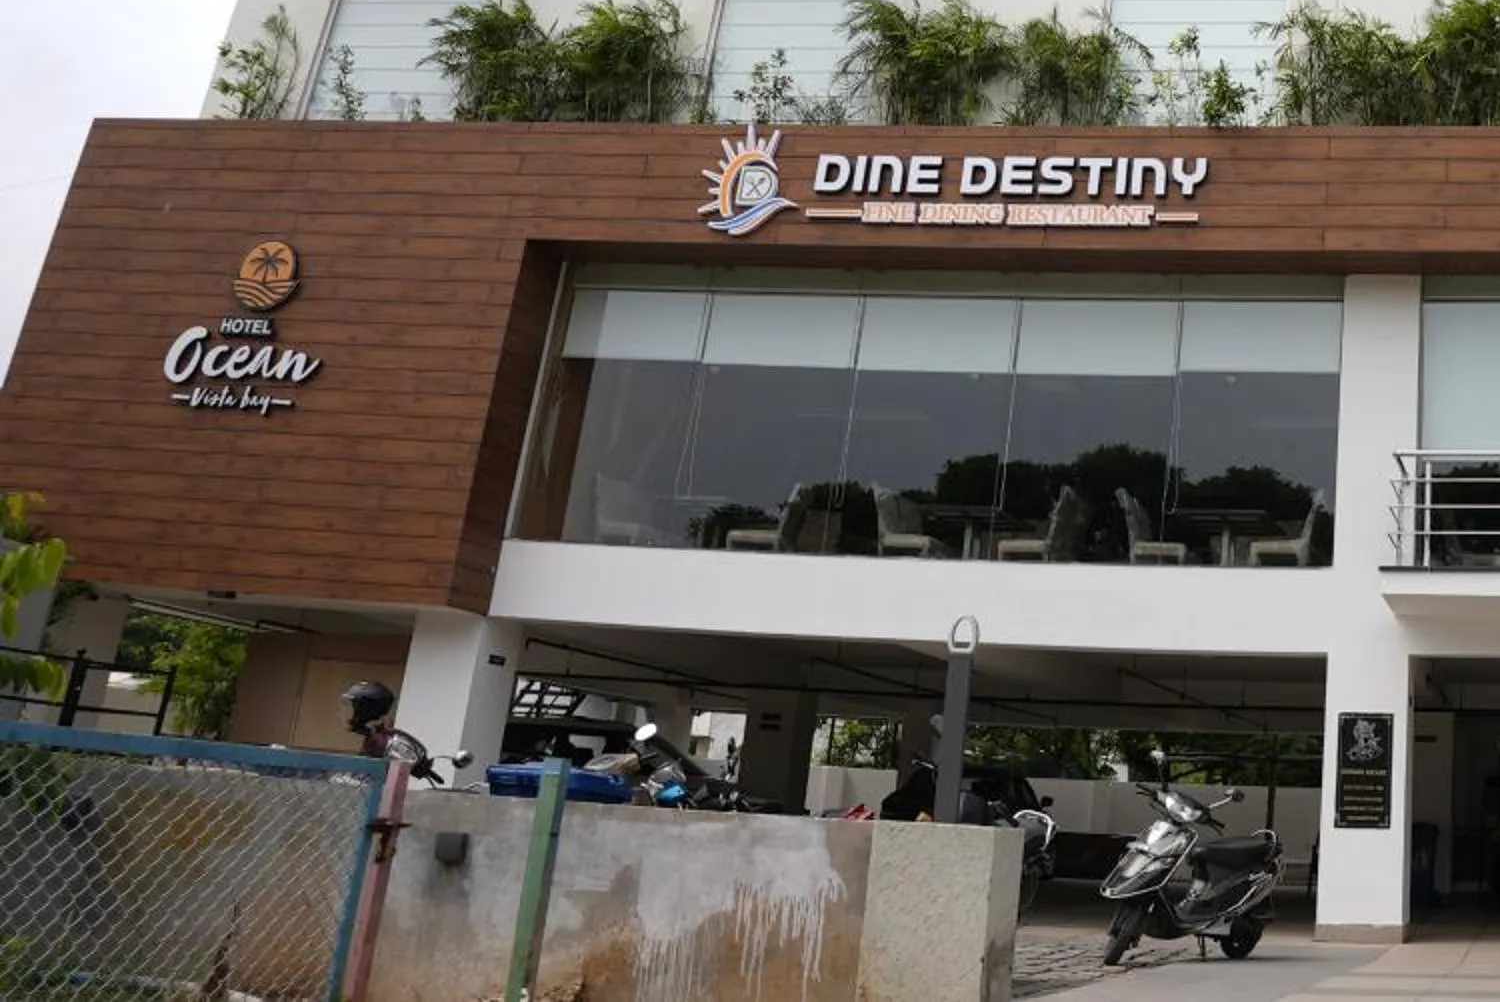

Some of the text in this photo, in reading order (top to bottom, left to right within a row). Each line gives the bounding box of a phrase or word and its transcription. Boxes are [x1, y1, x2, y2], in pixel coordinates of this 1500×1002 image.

[813, 153, 1209, 196] DINE DESTINY
[862, 202, 1155, 226] FINE DINING RESTAURANT
[219, 318, 272, 334] HOTEL
[163, 325, 321, 383] Ocean
[190, 385, 237, 407] Vista
